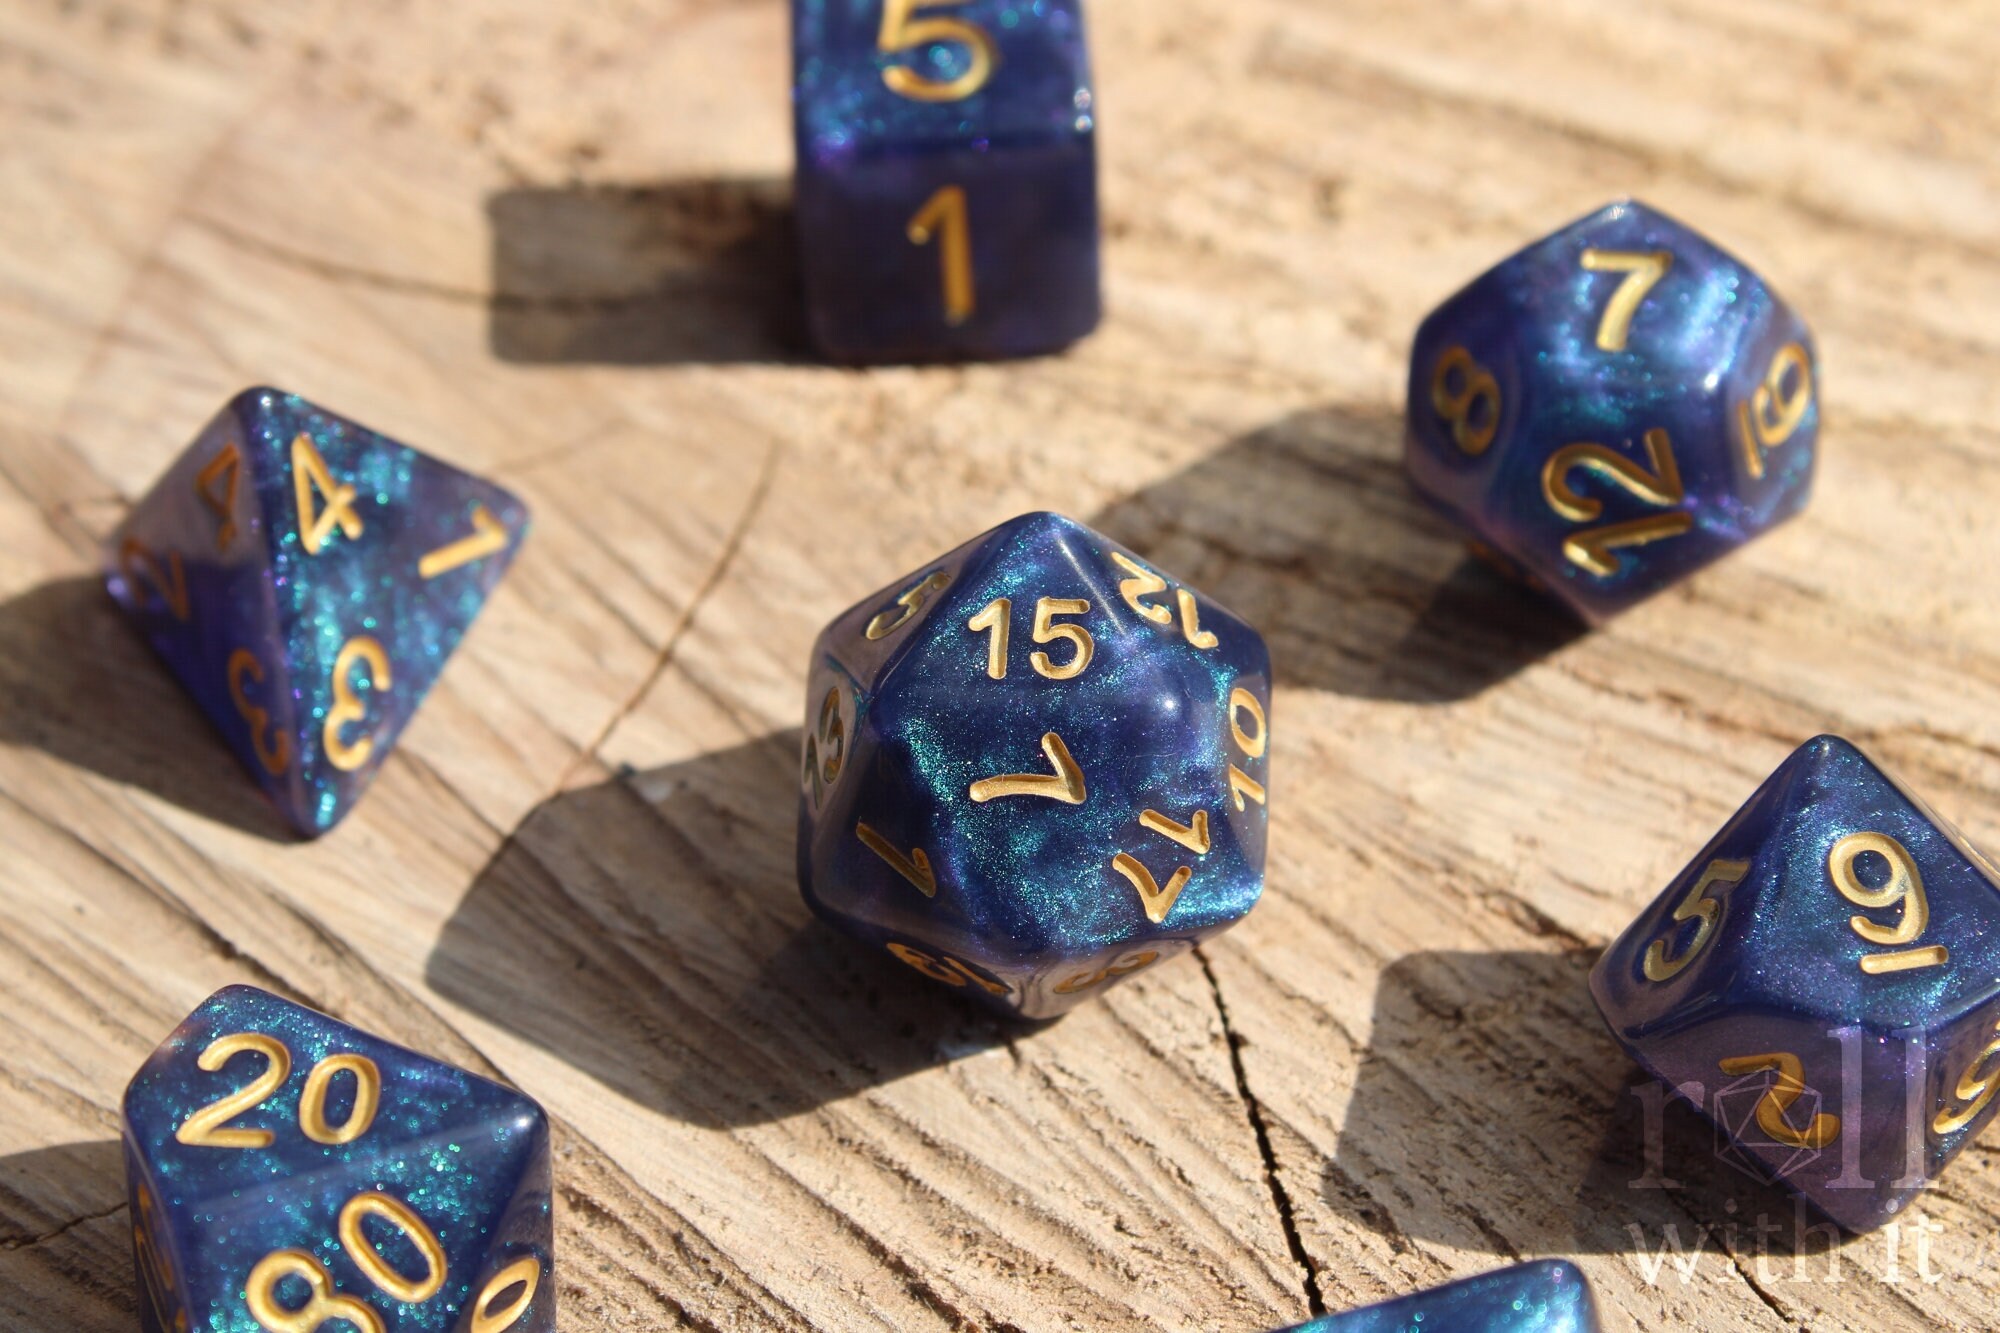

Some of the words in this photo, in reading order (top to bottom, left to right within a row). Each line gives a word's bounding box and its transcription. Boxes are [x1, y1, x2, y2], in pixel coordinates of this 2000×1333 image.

[878, 0, 995, 103] 5
[907, 185, 975, 326] 1
[1580, 248, 1674, 352] 7
[1431, 344, 1499, 456] 8
[195, 442, 241, 552] 4
[291, 432, 363, 555] 4
[418, 505, 510, 580] 1
[1541, 427, 1692, 577] 12
[865, 570, 950, 640] 5
[968, 597, 1095, 680] 15
[1111, 551, 1219, 649] 12
[227, 646, 290, 775] 3
[322, 636, 391, 771] 3
[1229, 686, 1267, 813] 10
[969, 731, 1087, 805] 7
[1112, 808, 1210, 923] 17
[1642, 857, 1751, 983] 5
[175, 1032, 382, 1149] 20
[1718, 1051, 1841, 1149] 2
[245, 1190, 448, 1333] 80
